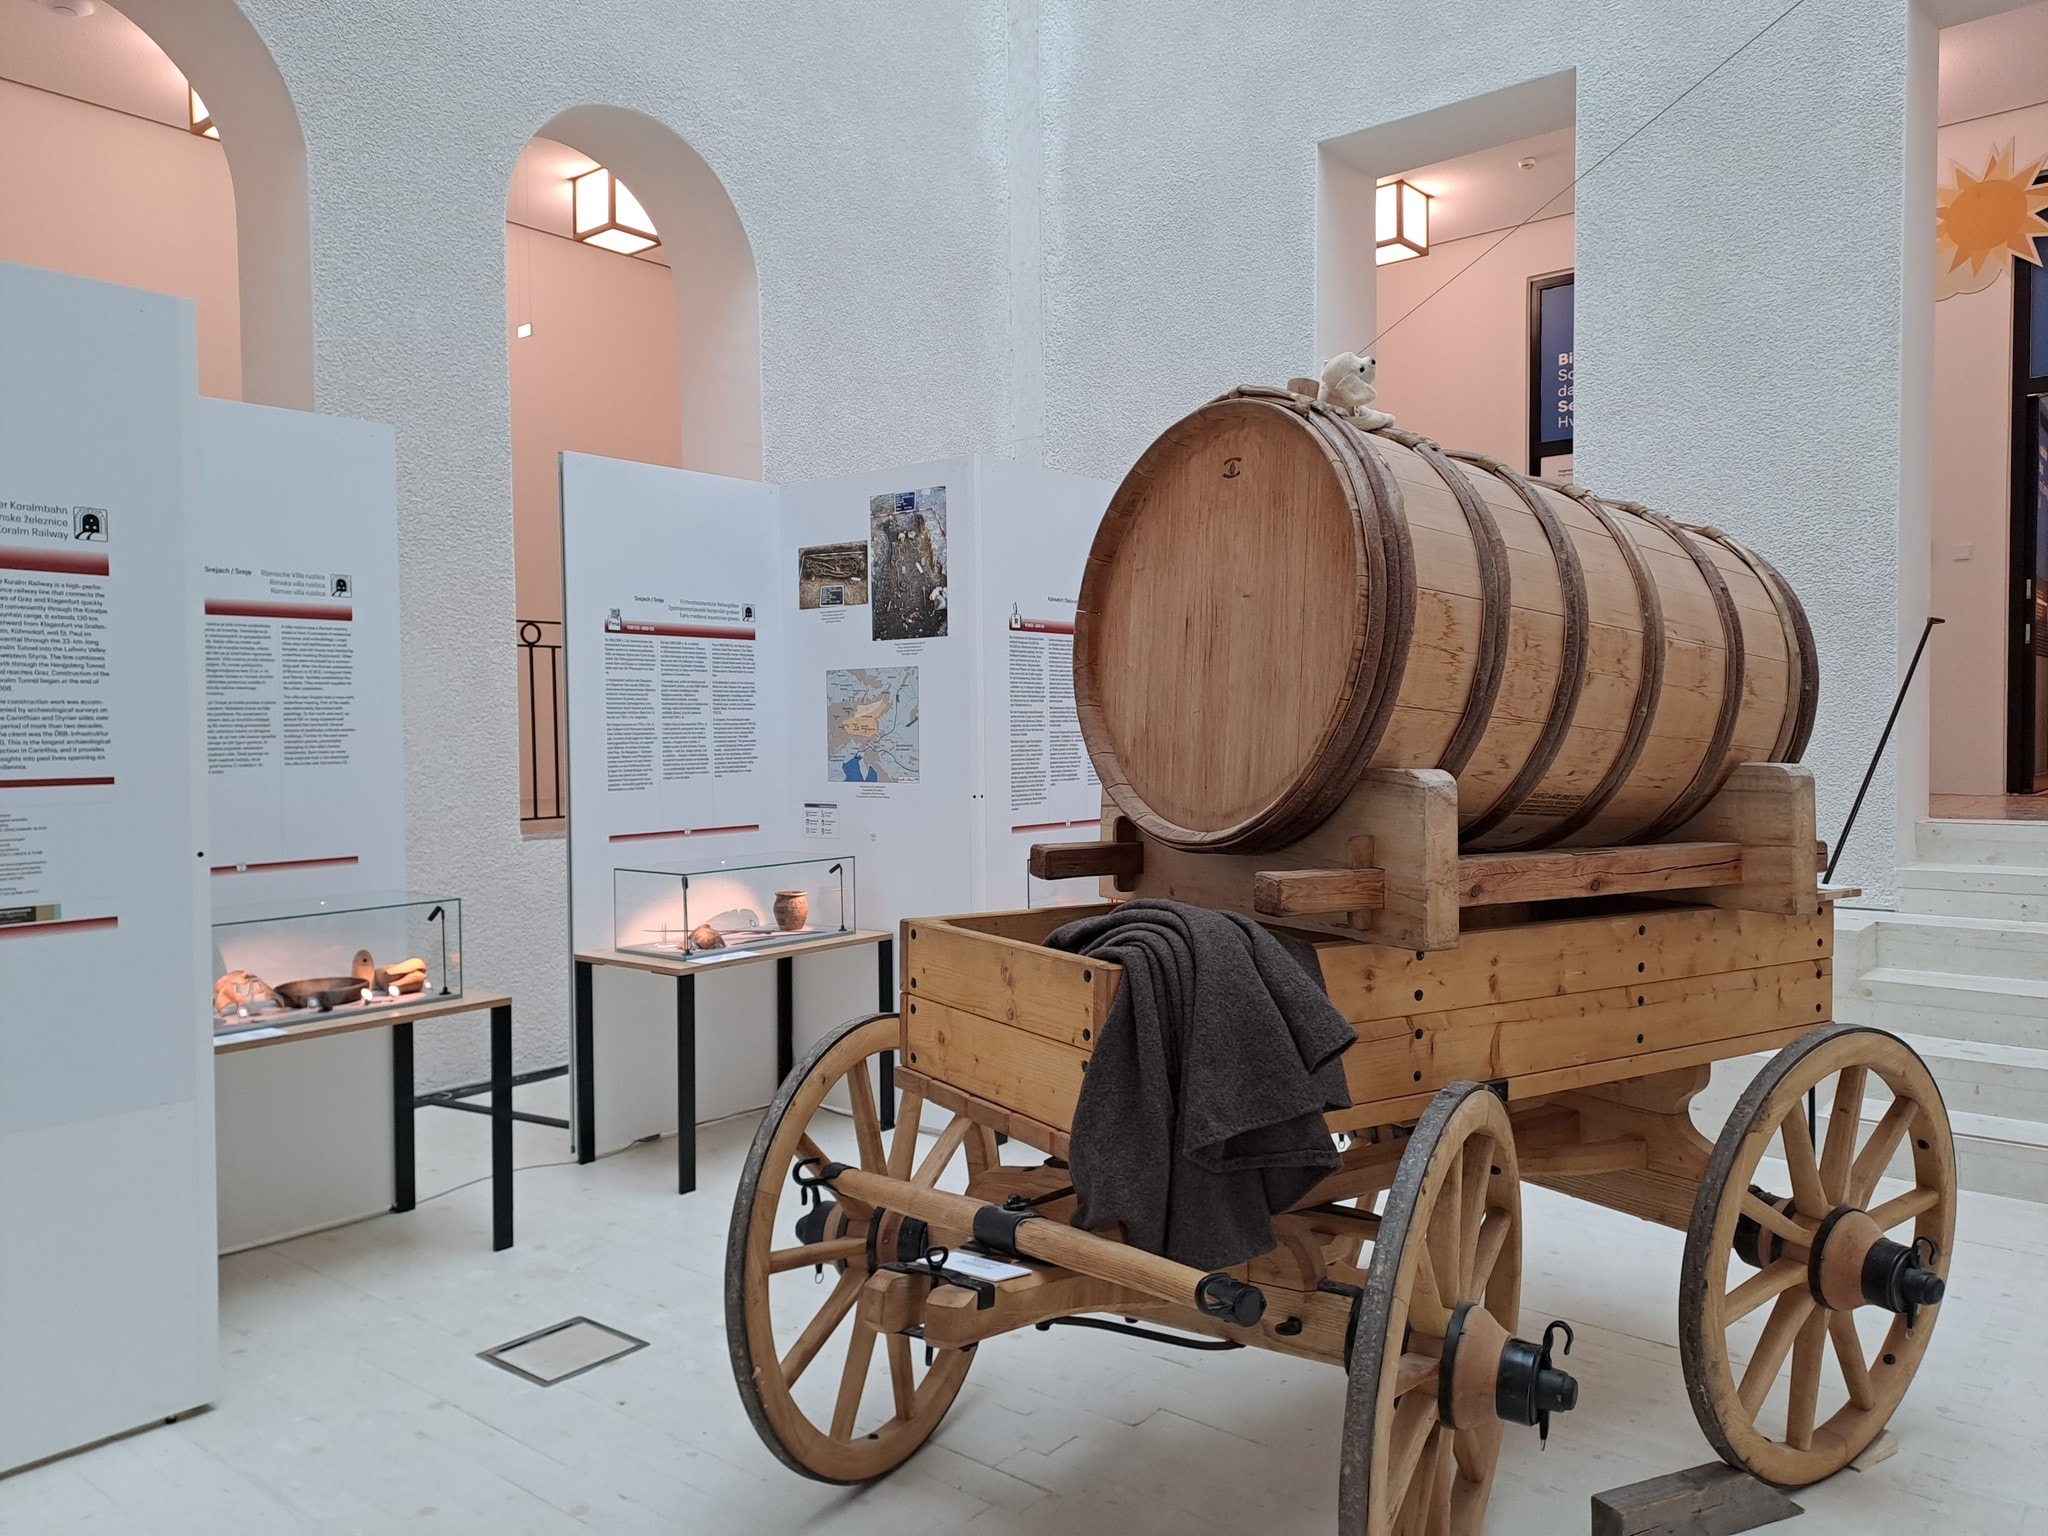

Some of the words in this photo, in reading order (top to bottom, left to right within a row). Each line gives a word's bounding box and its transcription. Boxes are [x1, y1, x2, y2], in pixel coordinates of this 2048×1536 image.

[10, 500, 68, 515] Koralmbahn
[0, 525, 30, 536] oralm
[31, 527, 69, 541] Railway
